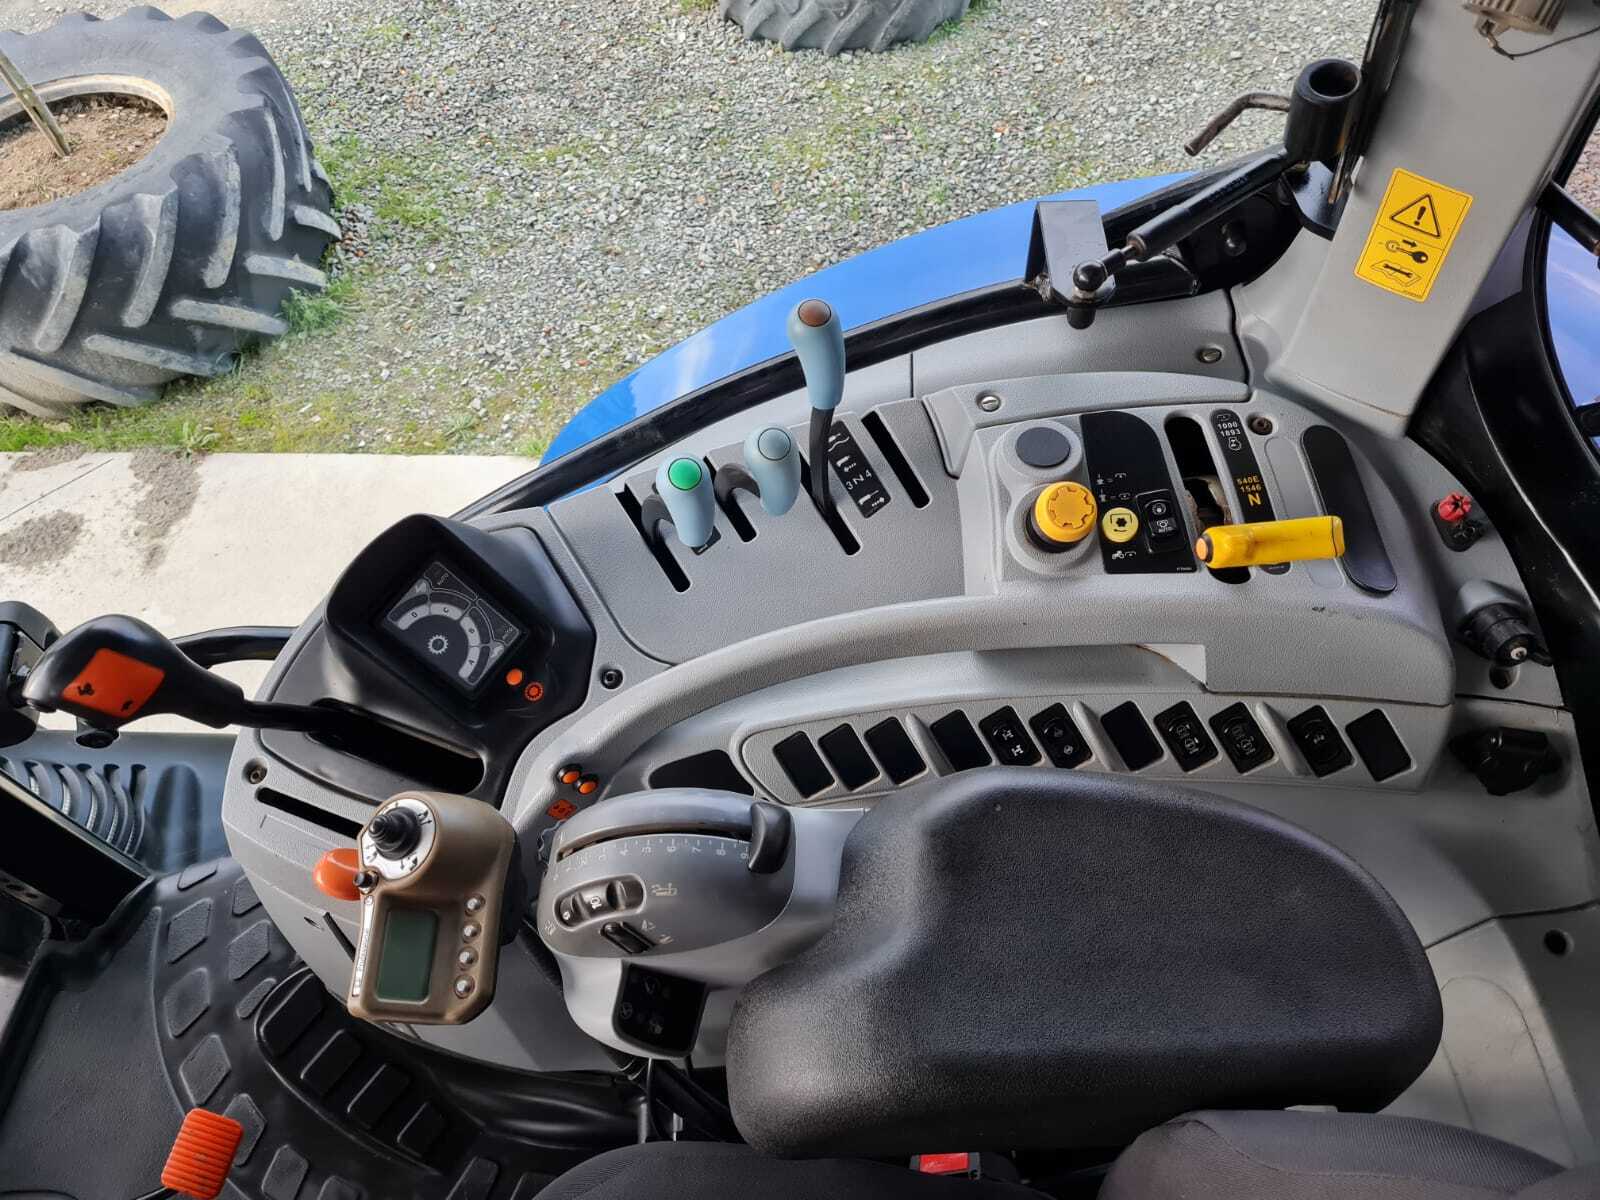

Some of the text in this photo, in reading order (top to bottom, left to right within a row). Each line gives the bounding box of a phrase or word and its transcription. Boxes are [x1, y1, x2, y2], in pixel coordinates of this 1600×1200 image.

[1220, 429, 1241, 438] 1893
[845, 469, 872, 490] 3 N 4
[1237, 475, 1260, 486] 540E
[1248, 493, 1261, 507] N
[591, 895, 602, 910] 10
